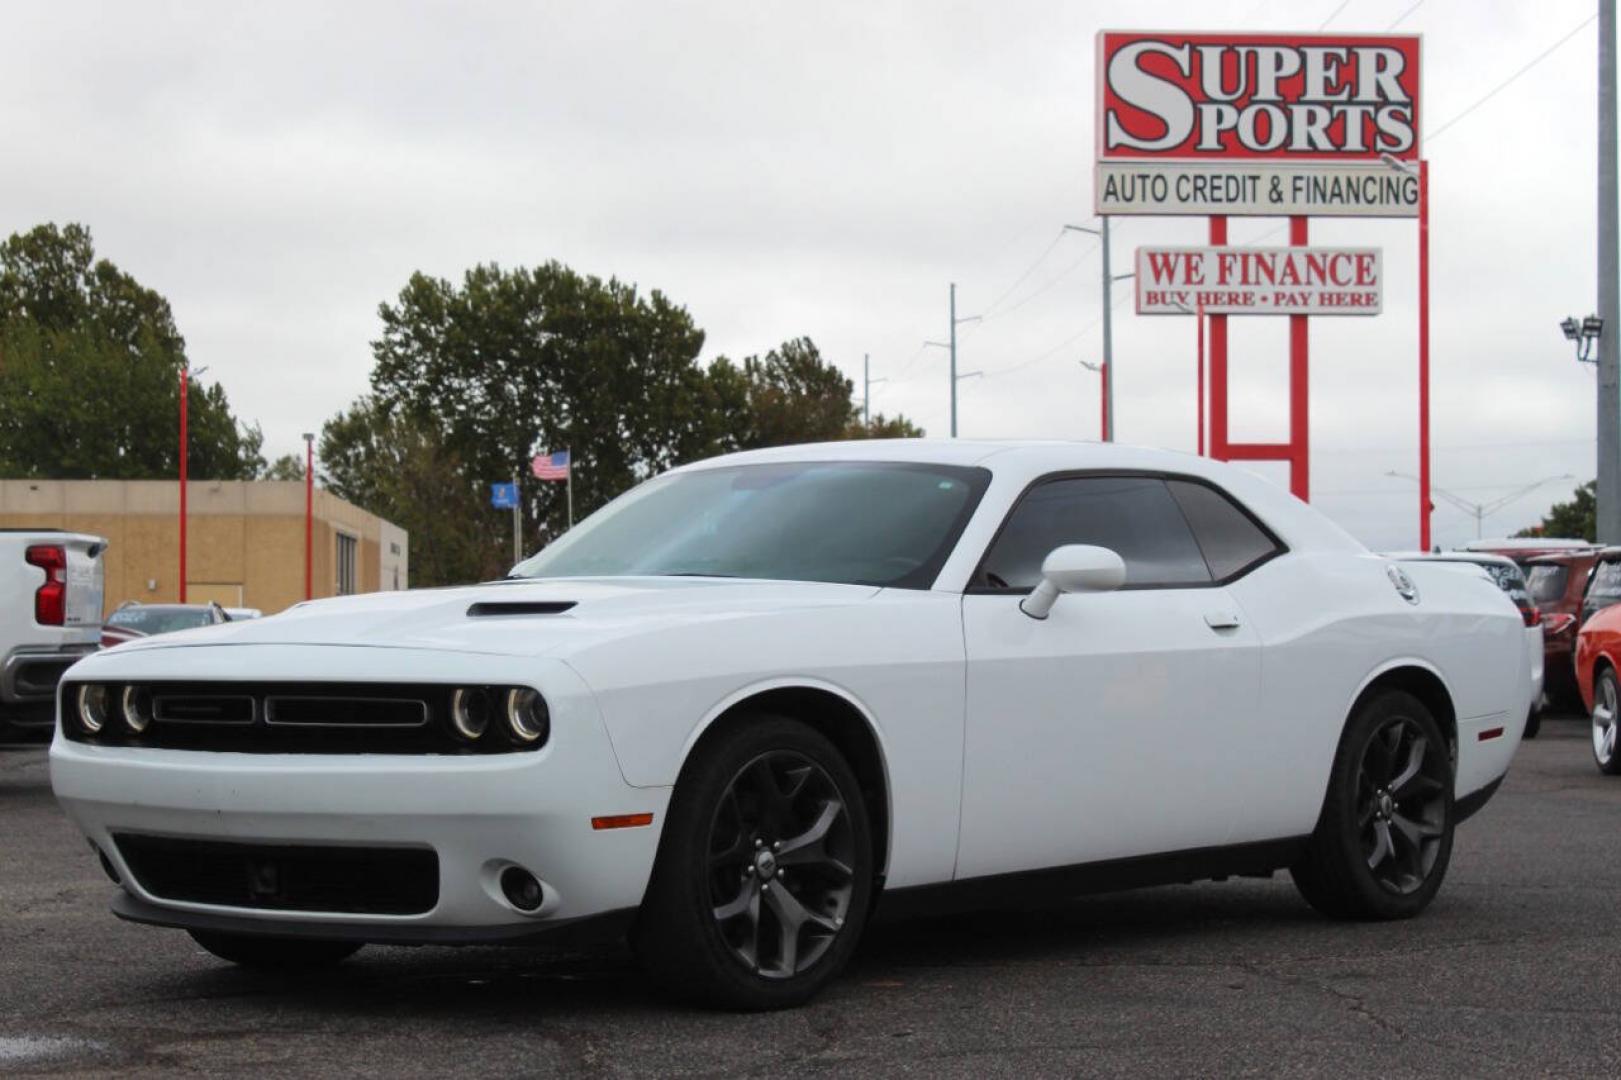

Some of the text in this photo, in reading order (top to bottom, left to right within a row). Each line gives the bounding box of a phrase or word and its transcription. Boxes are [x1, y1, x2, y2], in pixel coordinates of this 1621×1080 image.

[1107, 40, 1413, 151] SUPER
[1103, 174, 1418, 205] AUTO CREDIT & FINANCING
[1147, 252, 1377, 286] WE FINANCE
[1146, 291, 1378, 307] BUY HERE PAY HERE
